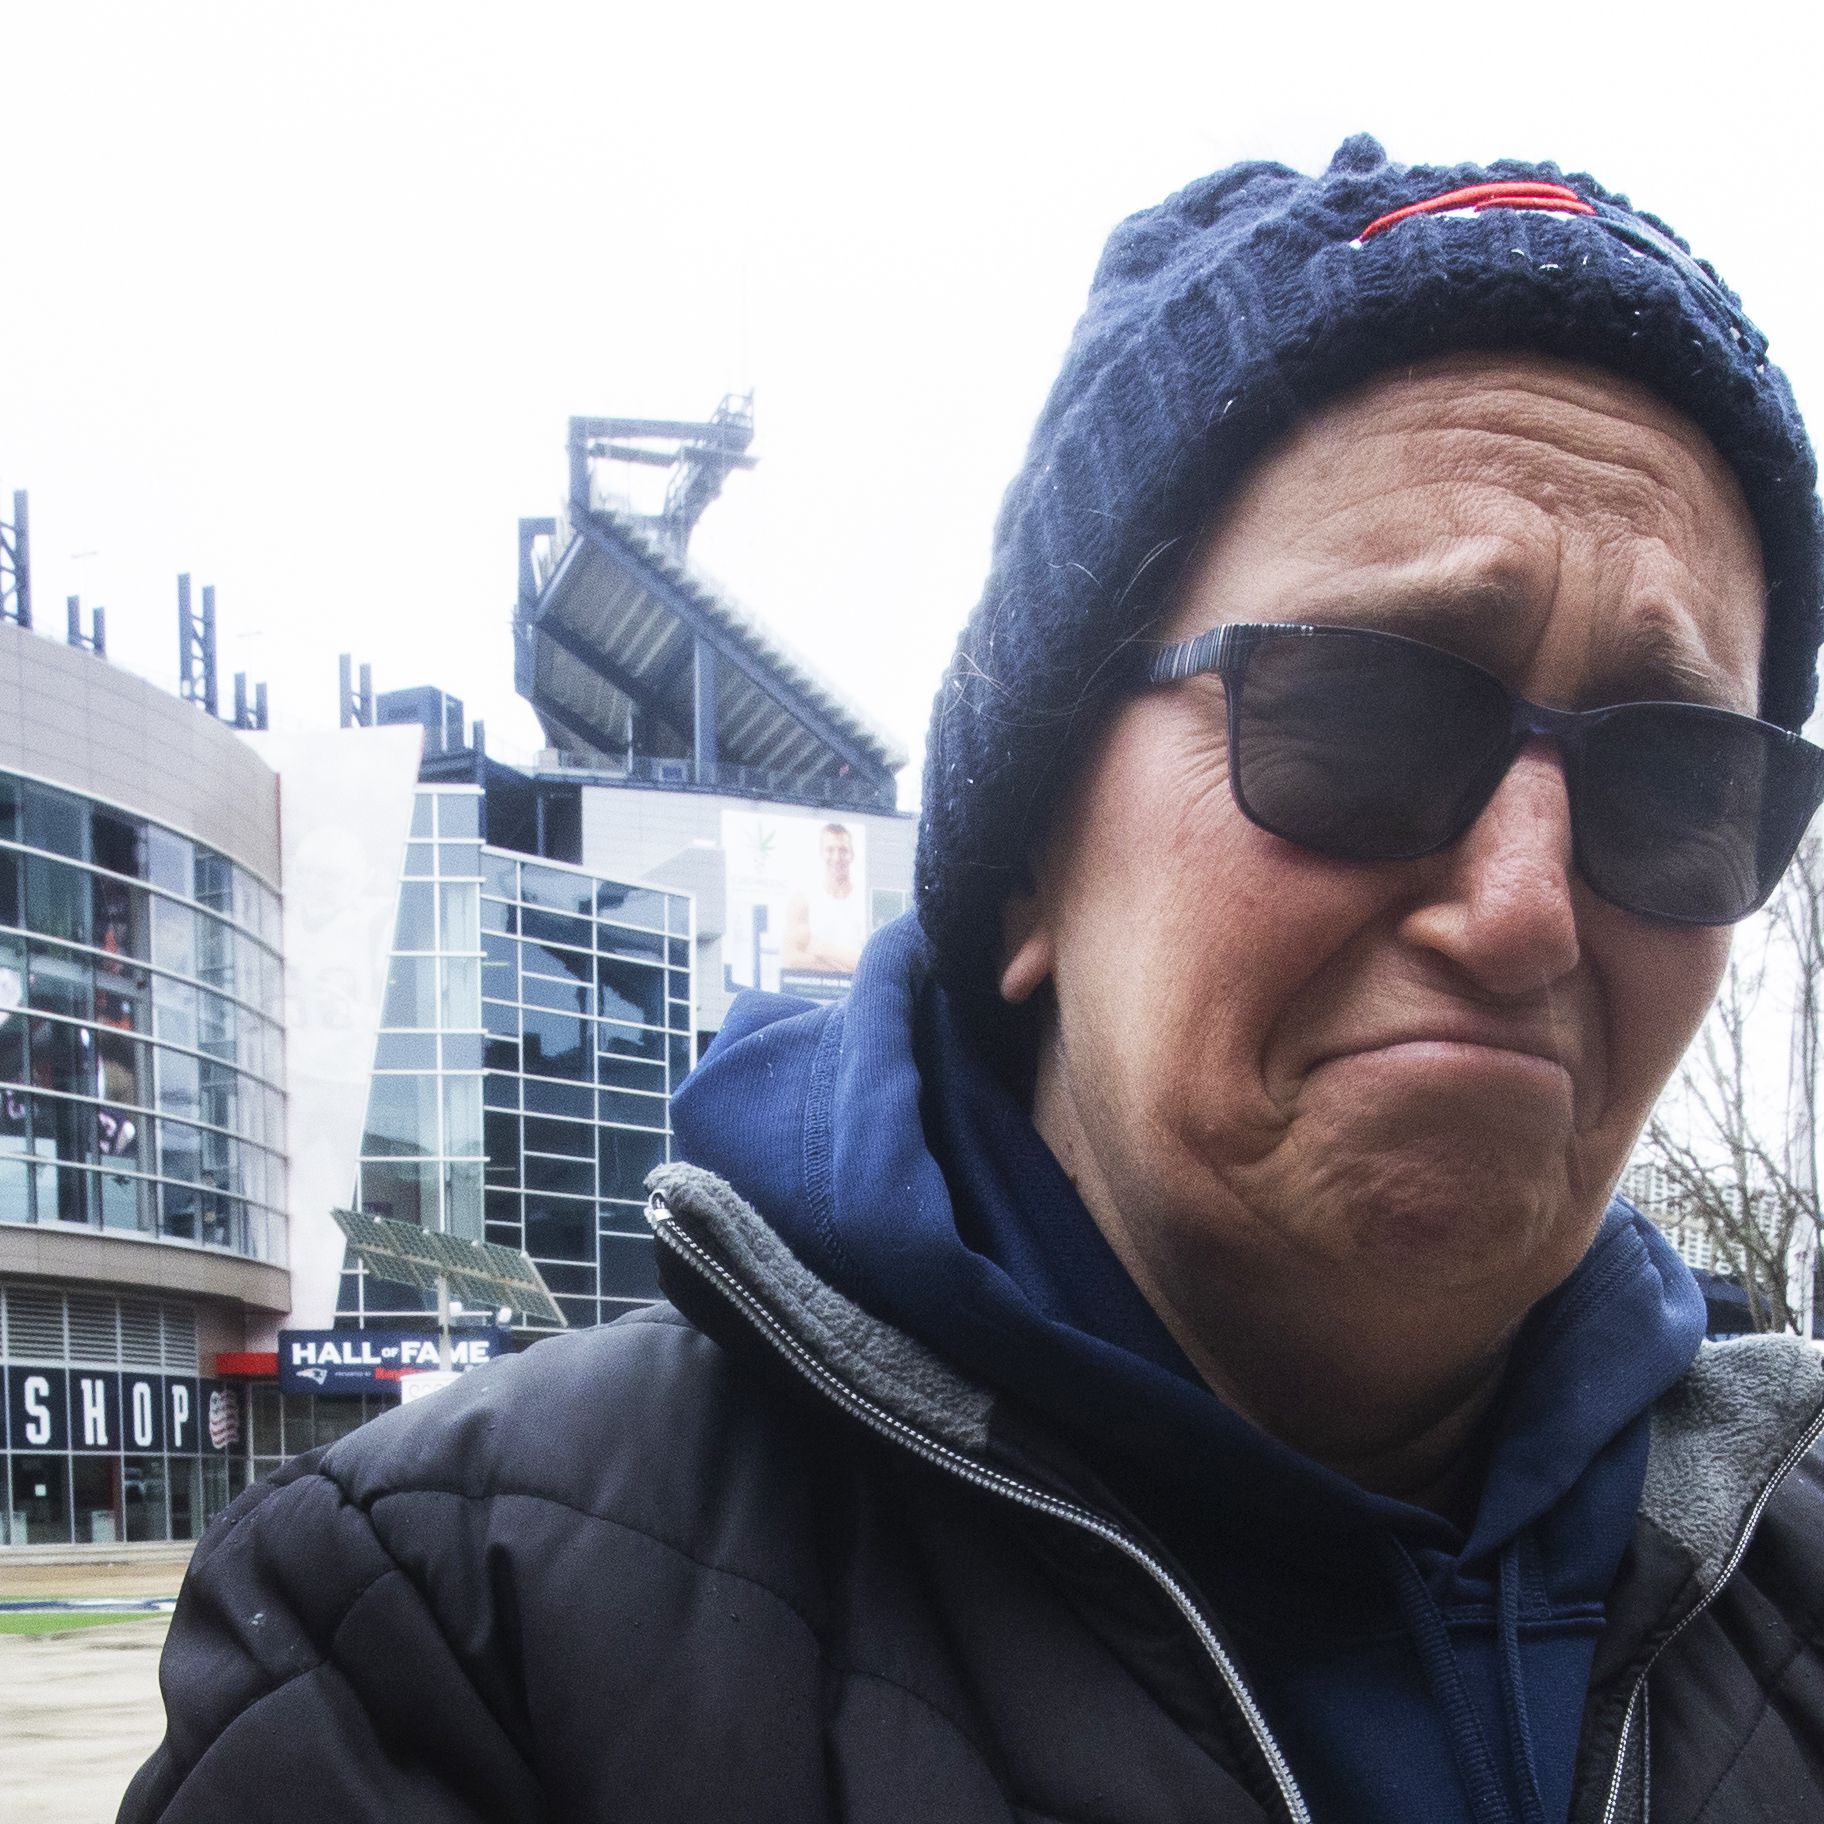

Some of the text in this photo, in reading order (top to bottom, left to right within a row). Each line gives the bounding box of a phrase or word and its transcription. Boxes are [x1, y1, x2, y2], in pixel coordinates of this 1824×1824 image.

[291, 1341, 382, 1366] HALL
[400, 1340, 491, 1364] FAME
[22, 1374, 190, 1449] SHOP
